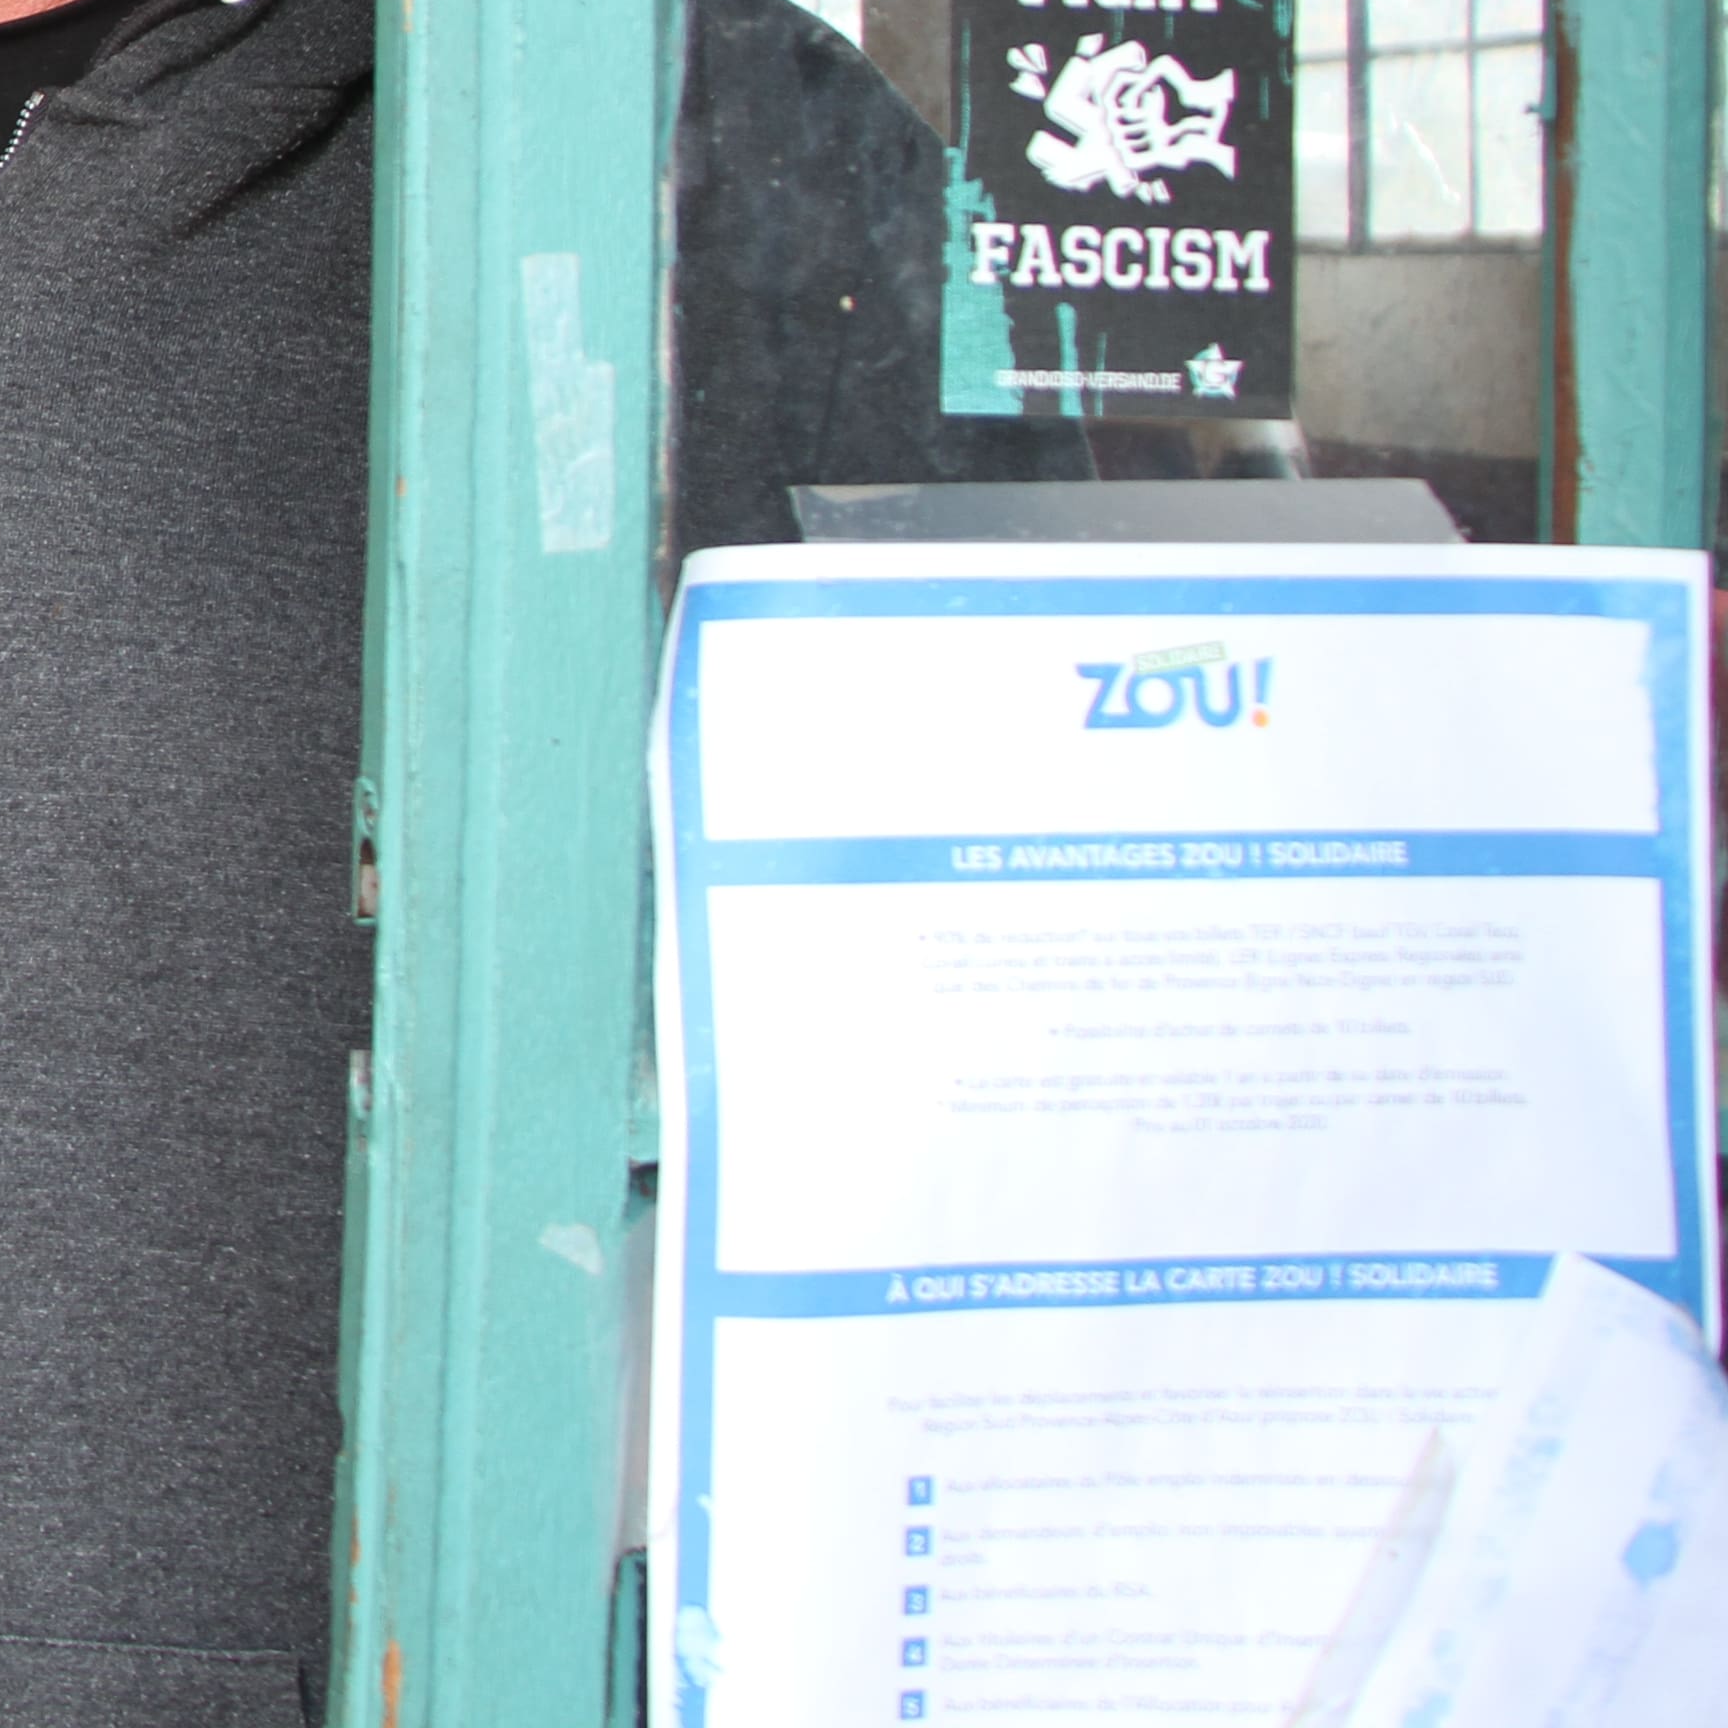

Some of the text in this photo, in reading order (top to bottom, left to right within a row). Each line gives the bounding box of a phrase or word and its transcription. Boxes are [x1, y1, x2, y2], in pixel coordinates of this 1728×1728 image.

[970, 222, 1269, 292] FASCISM
[952, 846, 1002, 870] LES
[1009, 843, 1175, 869] AVANTAGES
[1182, 843, 1244, 868] ZOU
[1267, 841, 1408, 867] SOLIDAIRE
[886, 1274, 909, 1304] À
[914, 1276, 965, 1301] QUI
[969, 1272, 1120, 1299] S'ADRESSE
[1126, 1269, 1162, 1295] LA
[1169, 1266, 1255, 1294] CARTE
[1263, 1265, 1324, 1290] ZOU
[1350, 1263, 1498, 1289] SOLIDAIRE
